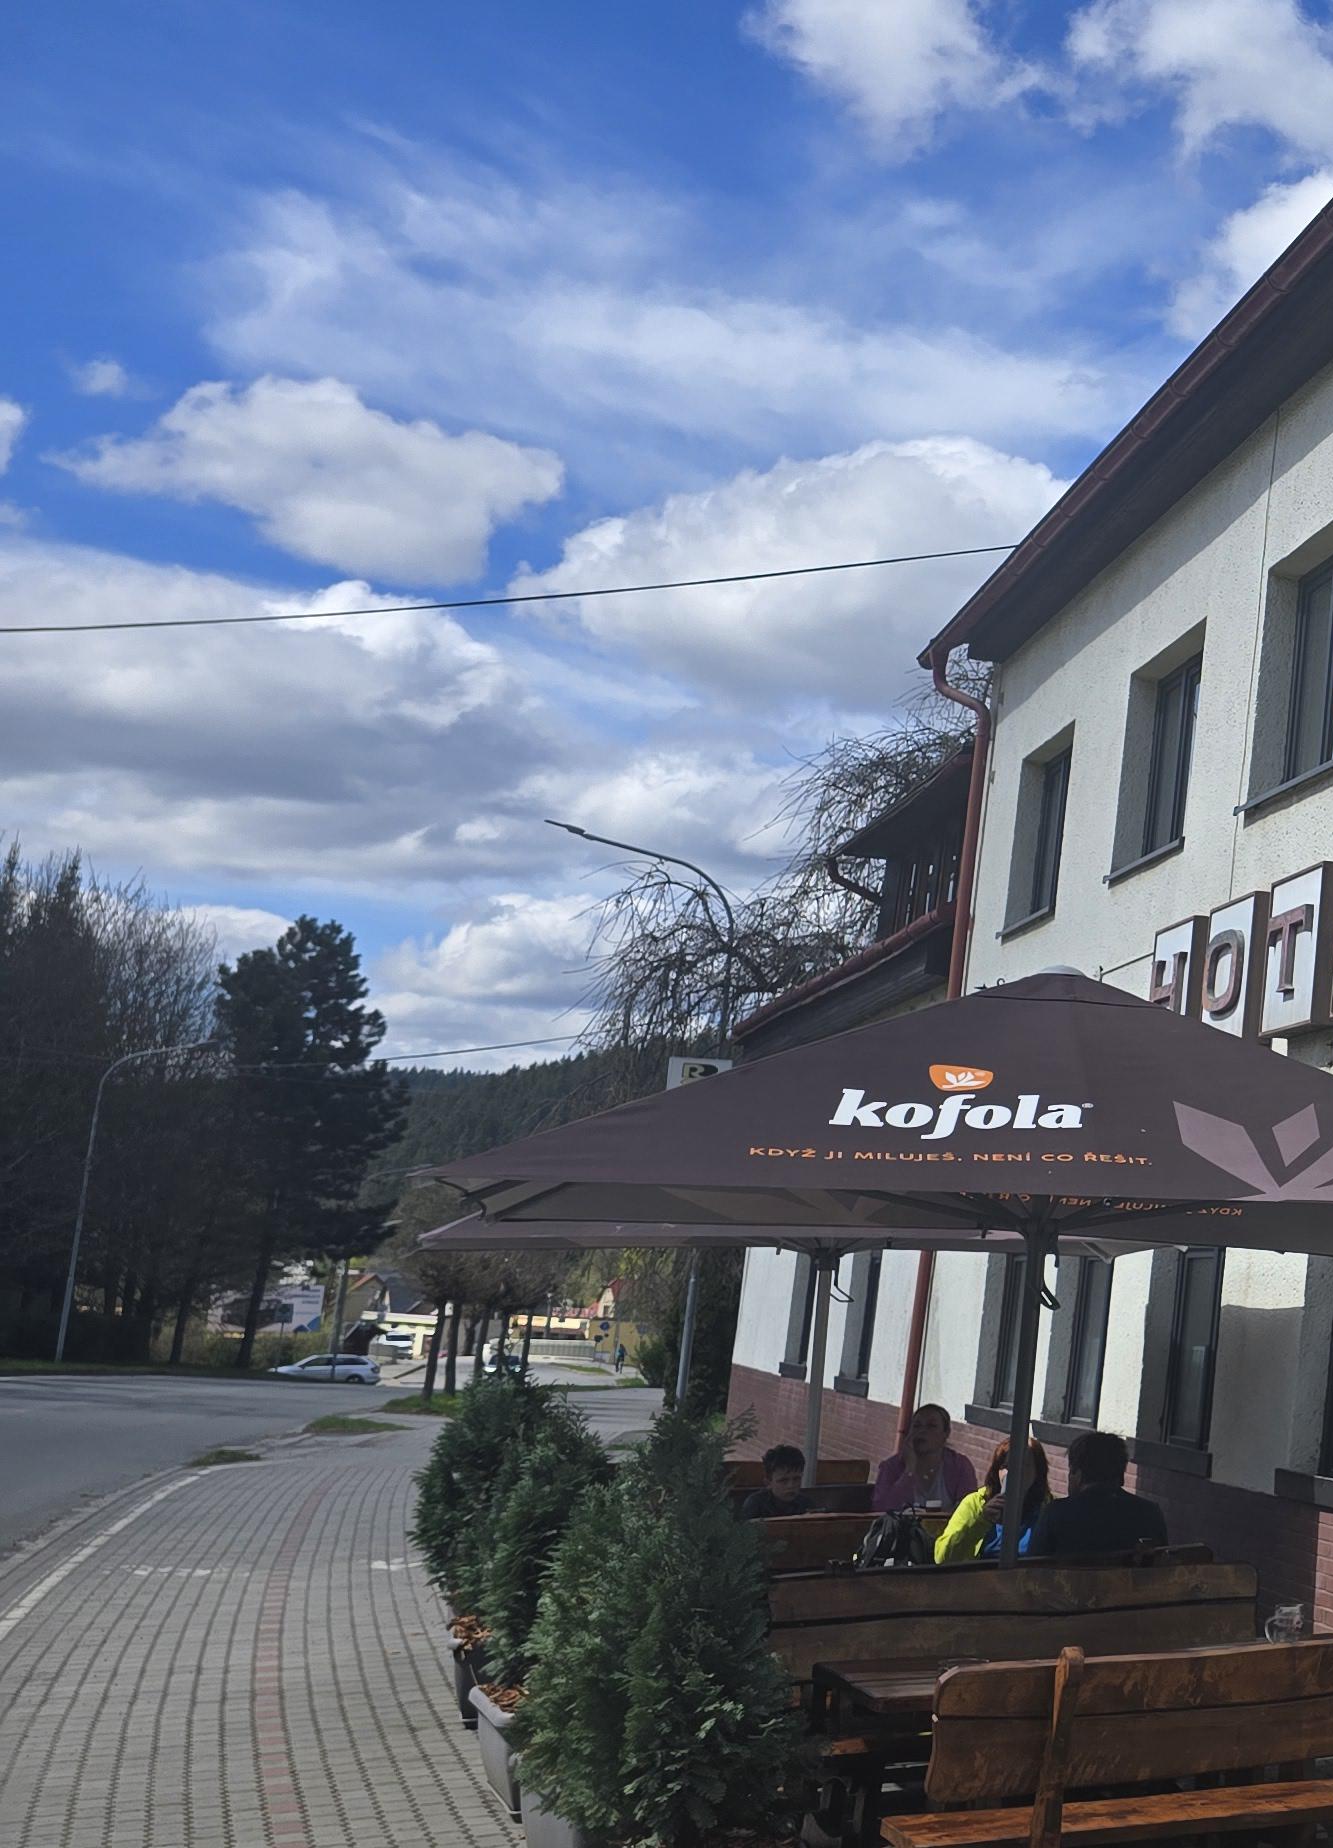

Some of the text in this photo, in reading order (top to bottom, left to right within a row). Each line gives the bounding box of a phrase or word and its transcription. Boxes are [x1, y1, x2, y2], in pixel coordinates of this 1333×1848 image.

[828, 1088, 1083, 1140] kofola
[749, 1147, 817, 1159] KDYŽ
[824, 1151, 843, 1160] JI
[973, 1152, 1031, 1162] NENÍ
[1041, 1154, 1074, 1162] CO
